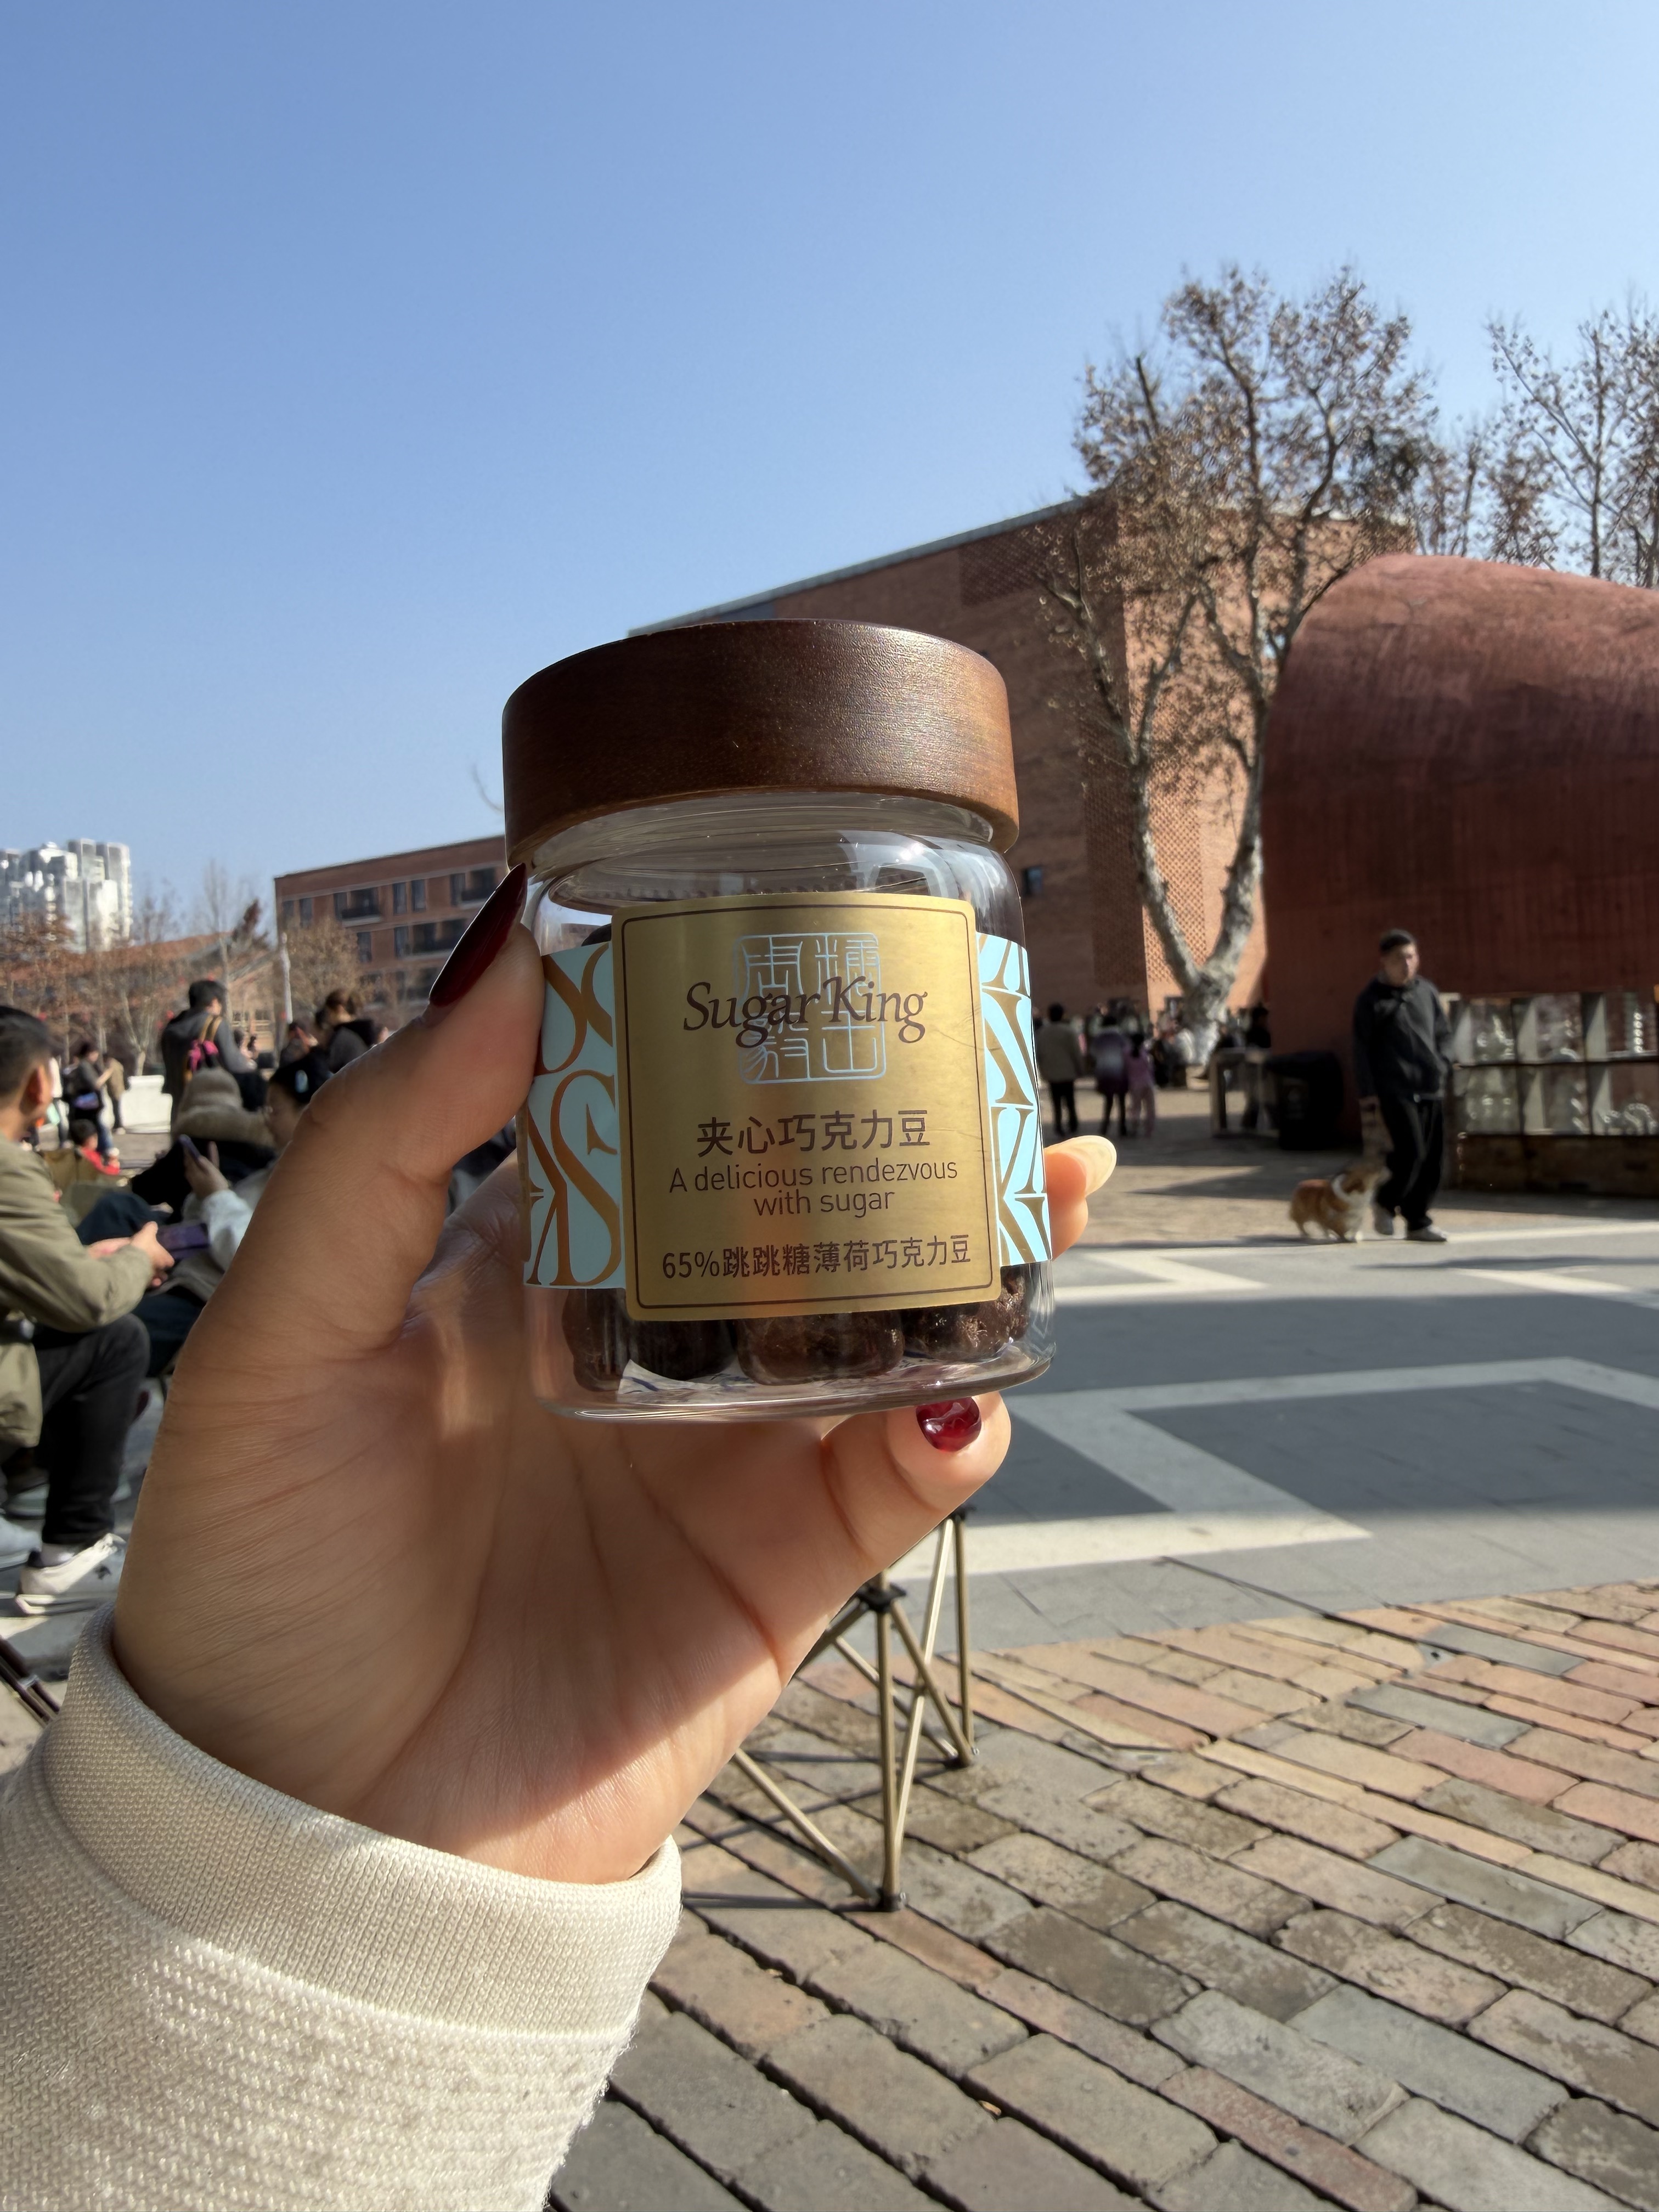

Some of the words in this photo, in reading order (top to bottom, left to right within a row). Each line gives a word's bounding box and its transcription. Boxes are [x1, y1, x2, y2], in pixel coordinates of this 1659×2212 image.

[684, 981, 821, 1048] Sugar
[823, 976, 928, 1043] King
[697, 1109, 930, 1158] 夹心巧克力豆
[669, 1167, 687, 1193] A
[695, 1163, 813, 1191] delicious
[822, 1158, 957, 1184] rendezvous
[754, 1189, 811, 1216] with
[820, 1192, 895, 1218] sugar
[662, 1235, 970, 1279] 65%跳跳糖薄荷巧克力豆
